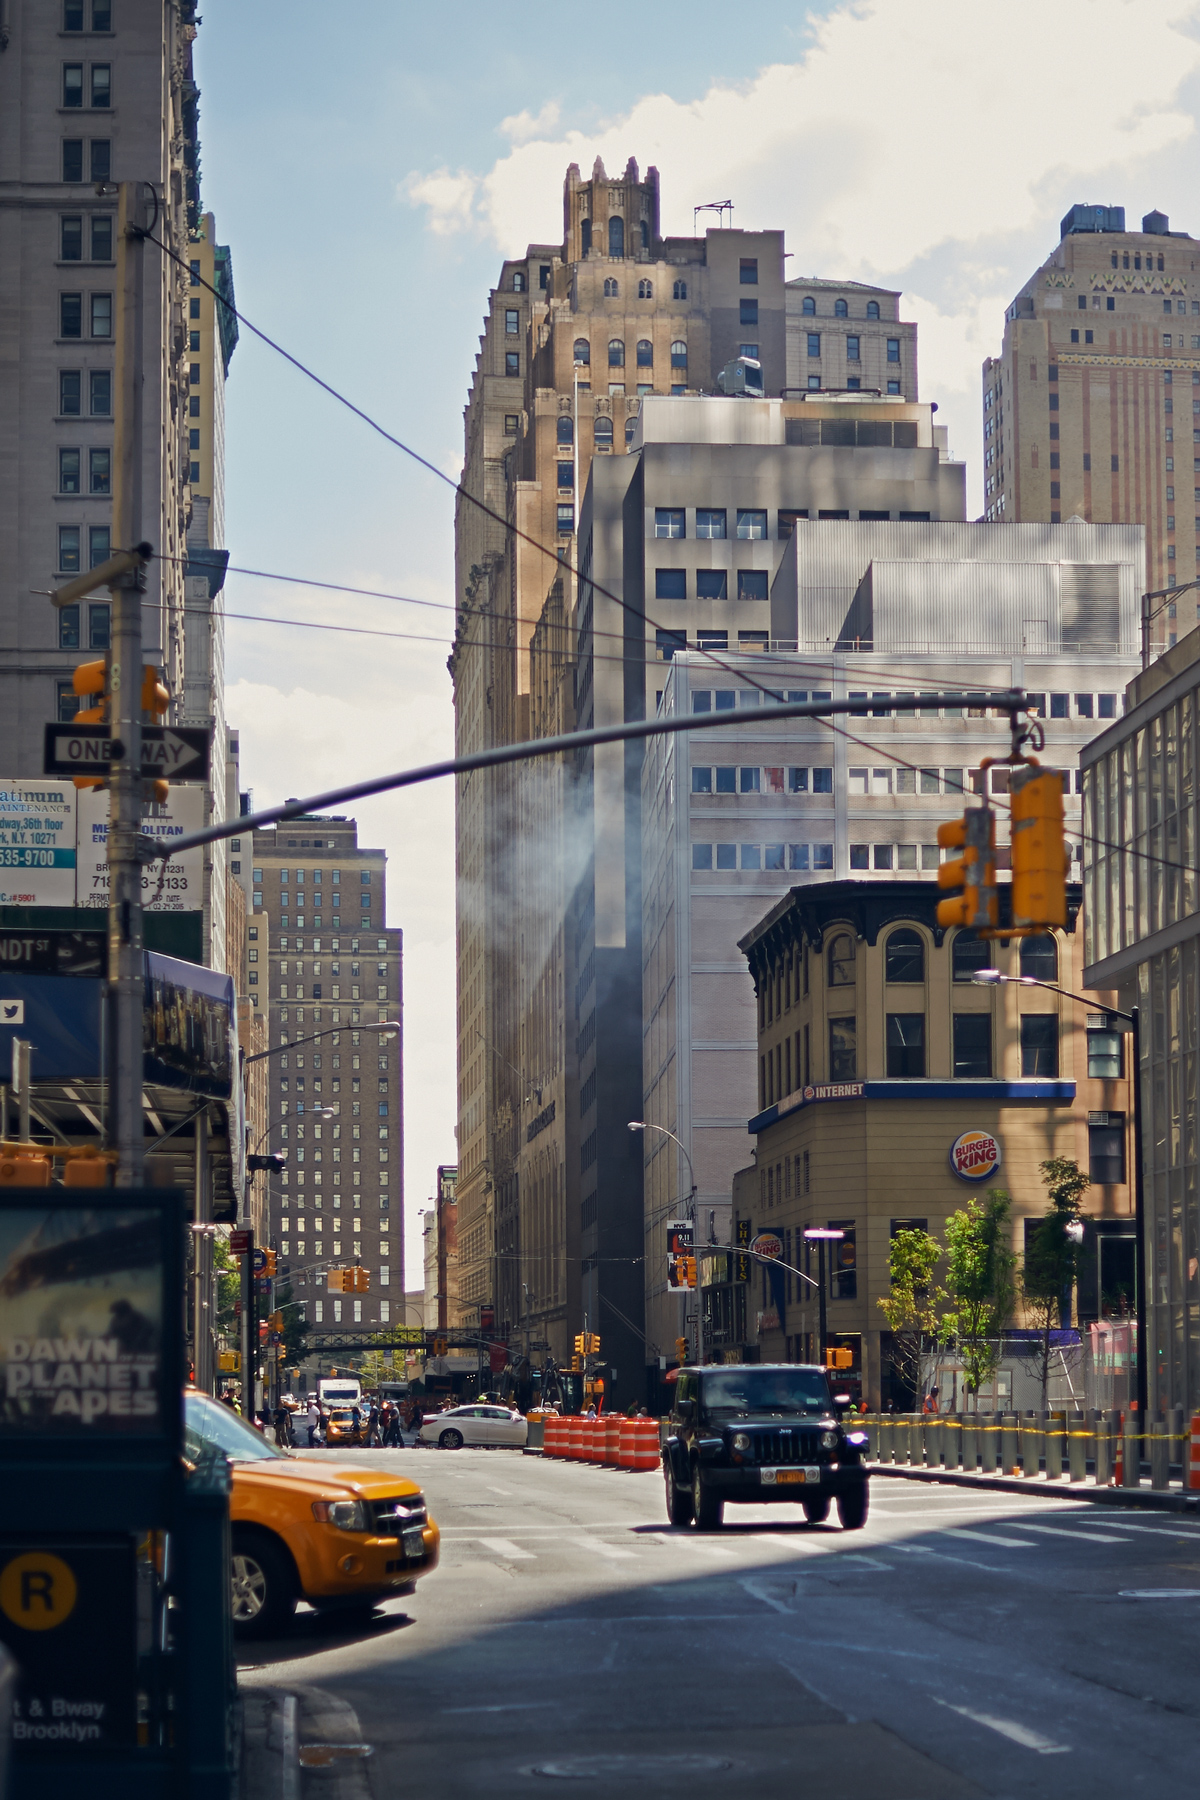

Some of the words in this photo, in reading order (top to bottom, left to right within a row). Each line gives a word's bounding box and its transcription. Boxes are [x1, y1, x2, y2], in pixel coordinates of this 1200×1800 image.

[68, 739, 111, 760] ONE
[44, 818, 63, 830] floor
[92, 824, 183, 836] MEOLITAN
[11, 832, 28, 844] N.Y.
[30, 833, 56, 845] 10271
[147, 865, 159, 873] NY
[36, 940, 49, 951] ST
[816, 1083, 864, 1098] INTERNET
[955, 1139, 995, 1158] BURGER
[957, 1148, 997, 1171] KING
[739, 1222, 747, 1280] CHALYS
[7, 1338, 118, 1362] DAWN
[6, 1363, 156, 1397] PLANET
[52, 1390, 158, 1423] APES
[21, 1571, 55, 1612] R
[29, 1699, 43, 1717] &
[52, 1699, 104, 1720] Bway
[14, 1721, 100, 1741] Brooklyn
